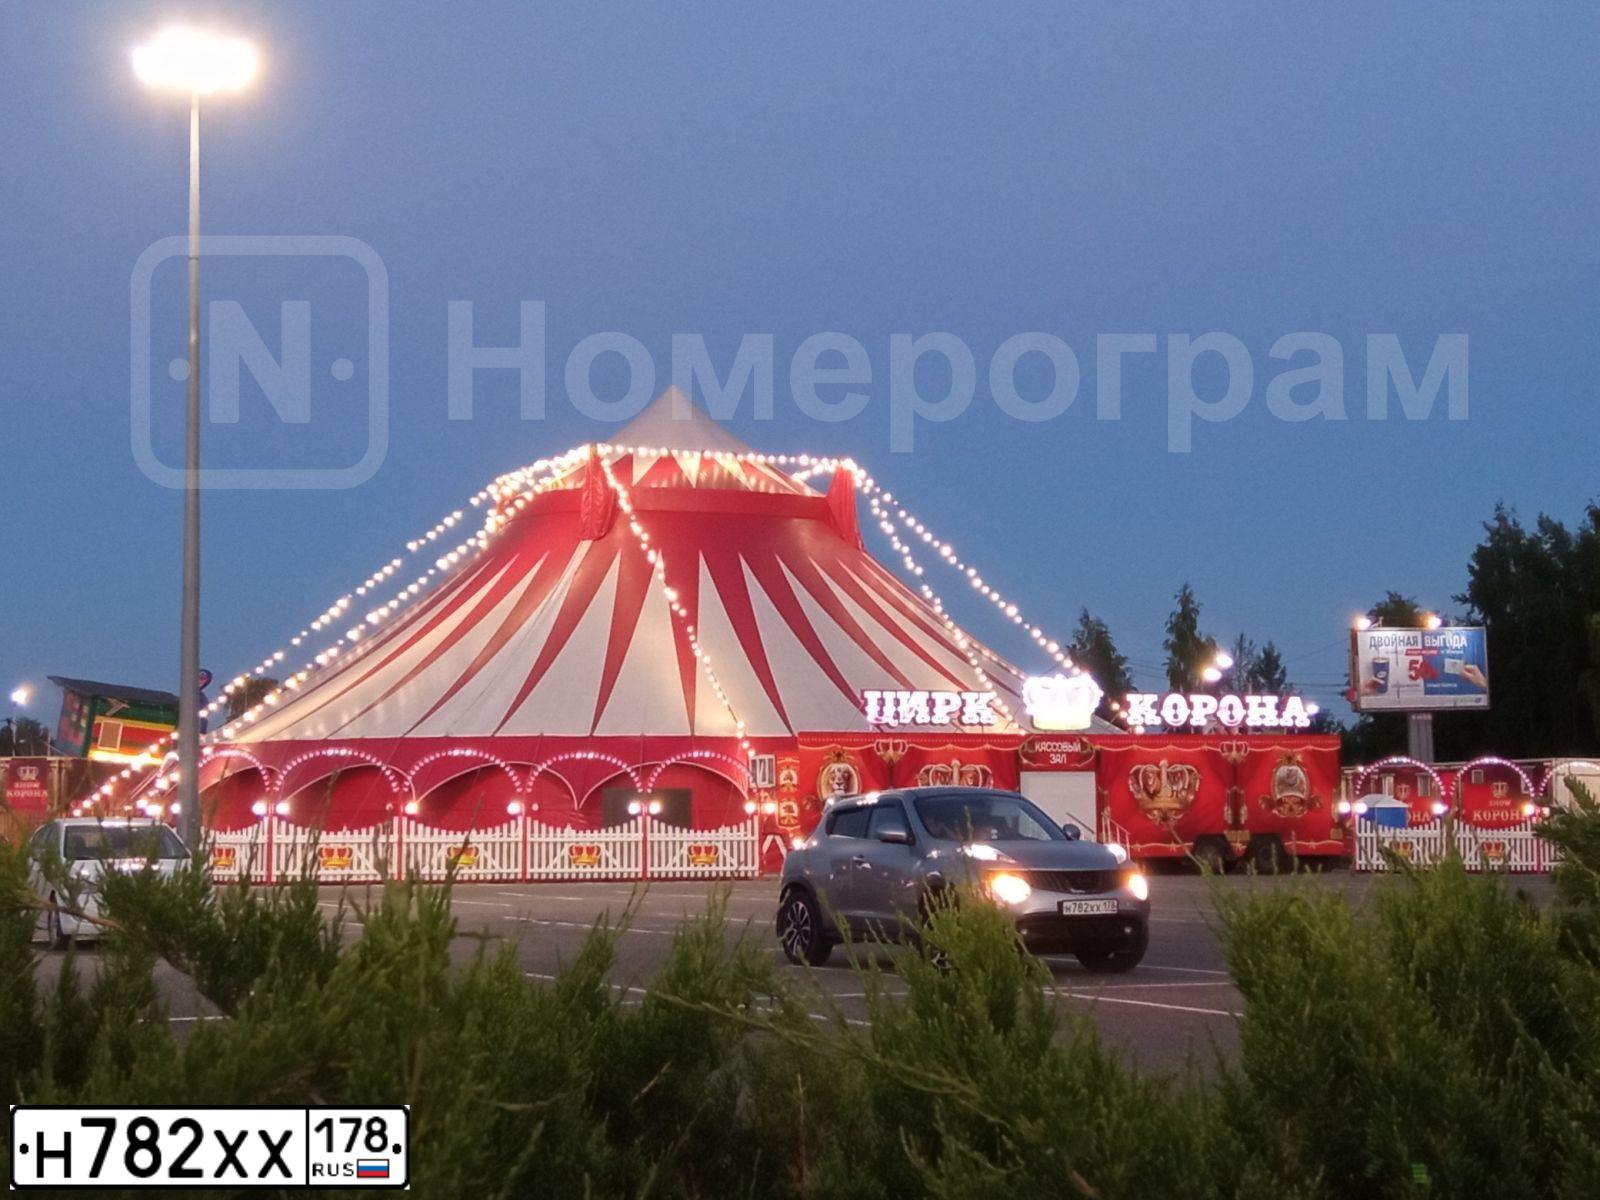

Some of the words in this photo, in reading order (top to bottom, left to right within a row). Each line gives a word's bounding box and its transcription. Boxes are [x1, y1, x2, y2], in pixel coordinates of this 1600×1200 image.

[1369, 635, 1419, 649] ДВОЙНАЯ
[1424, 635, 1468, 649] ВЫГОДА
[864, 690, 999, 727] ЦИРК
[1125, 693, 1309, 727] КОРОНА
[1034, 740, 1082, 753] КАССОВЫЙ
[1049, 753, 1067, 764] ЗАЛ
